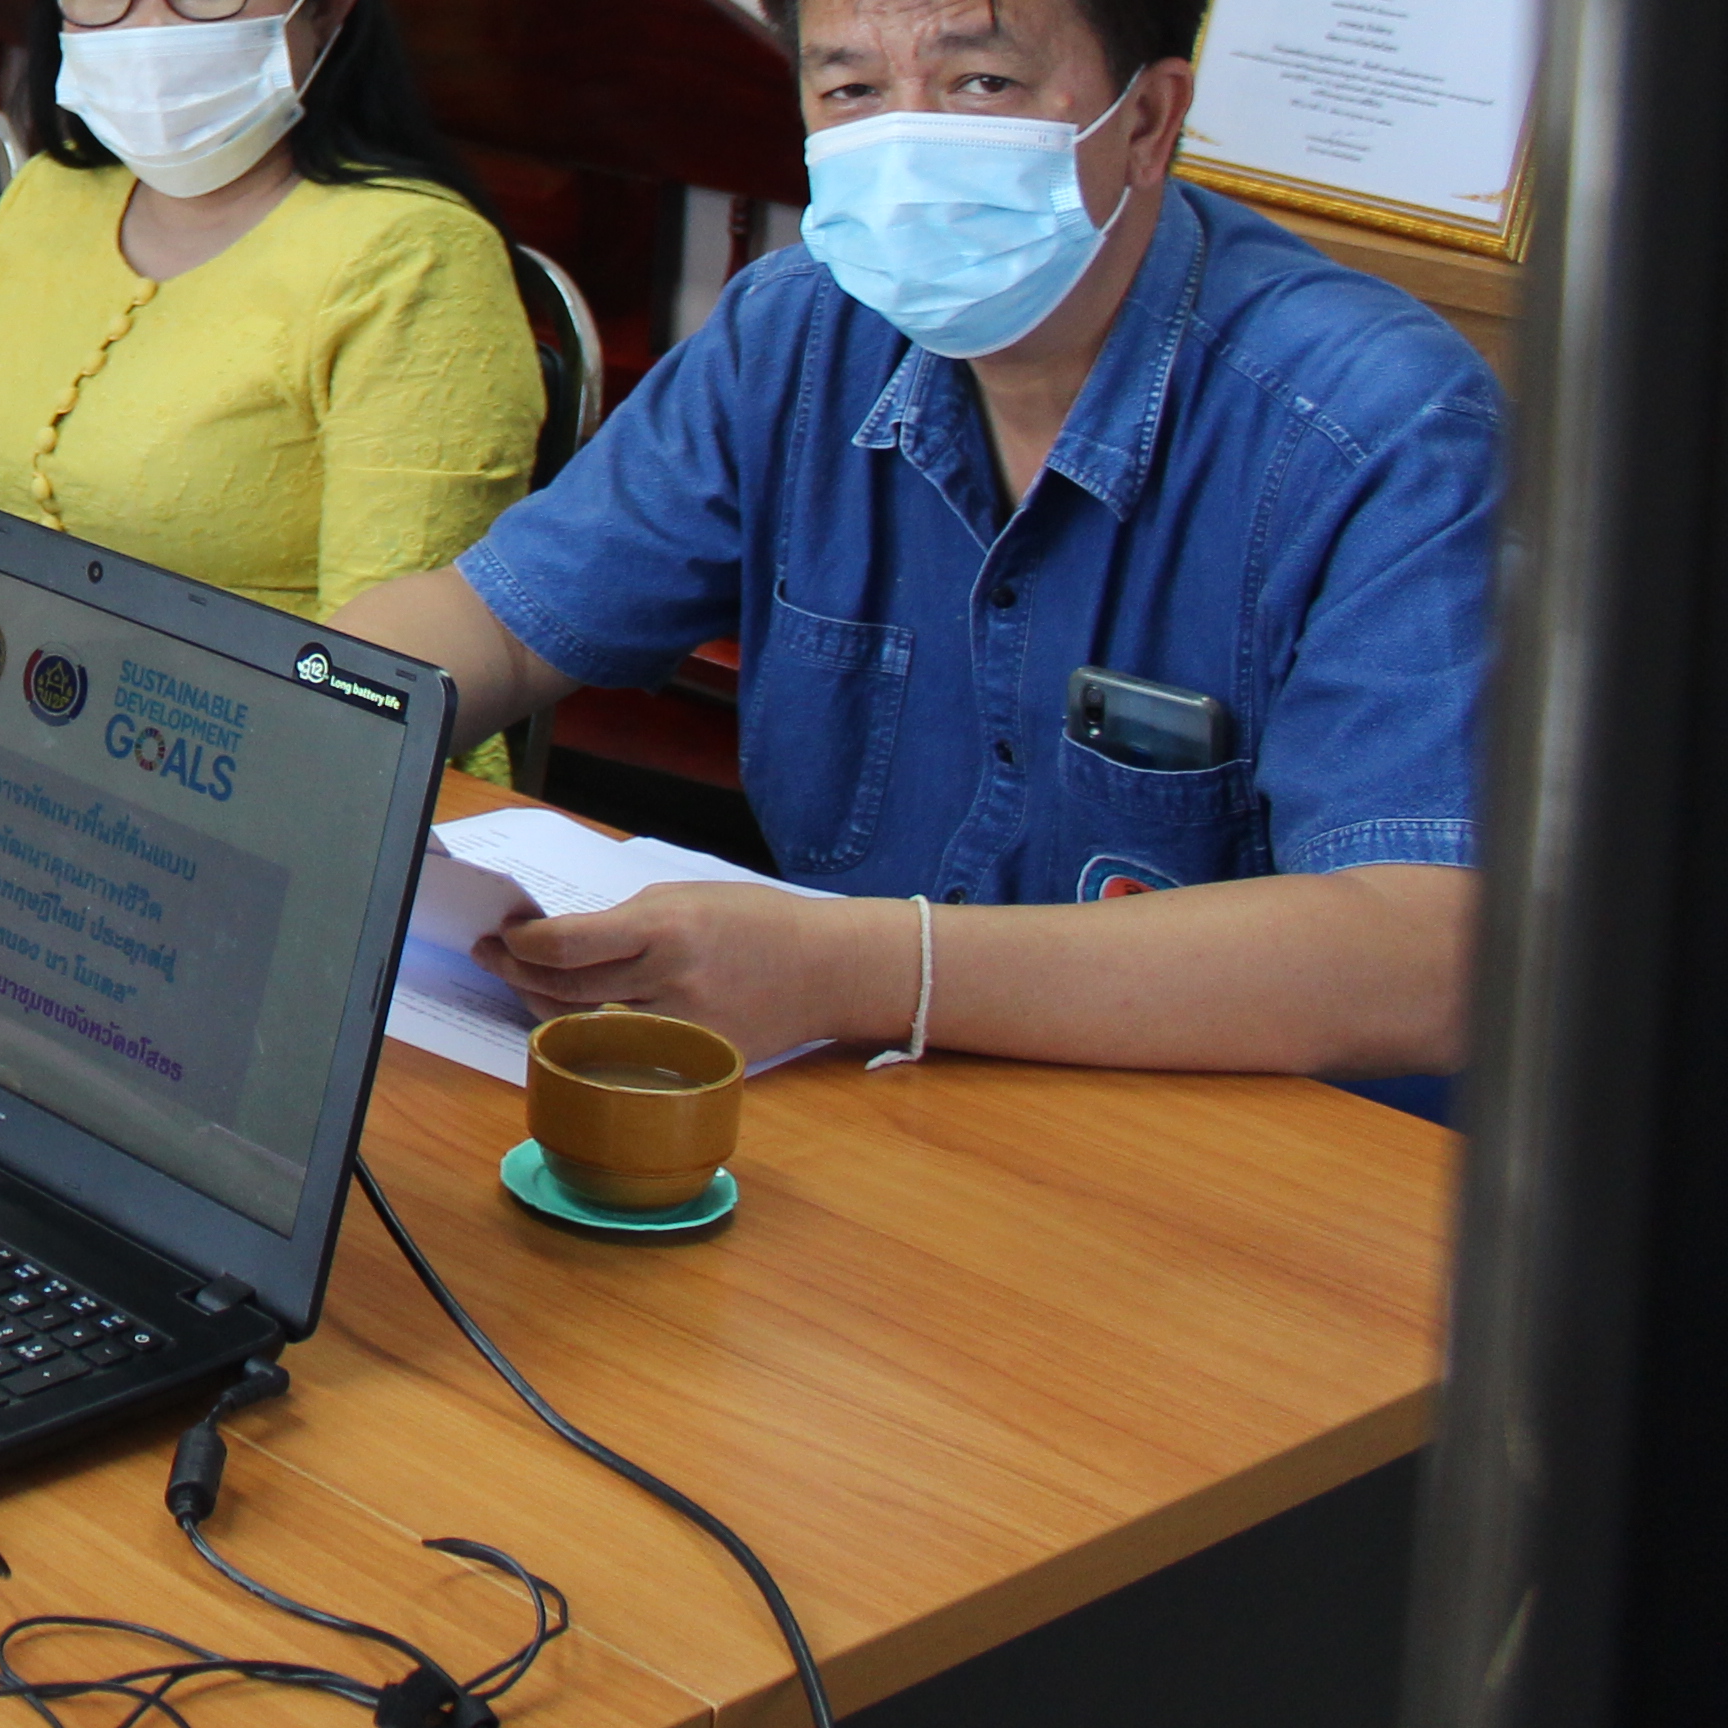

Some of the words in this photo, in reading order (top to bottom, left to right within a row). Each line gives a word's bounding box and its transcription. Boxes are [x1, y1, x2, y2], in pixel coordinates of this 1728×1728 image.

[113, 685, 243, 753] DEVELOPMENT
[119, 658, 248, 728] SUSTAINABLE
[330, 674, 352, 695] Long
[352, 682, 385, 707] battery
[384, 694, 401, 710] life
[104, 713, 237, 802] GOALS
